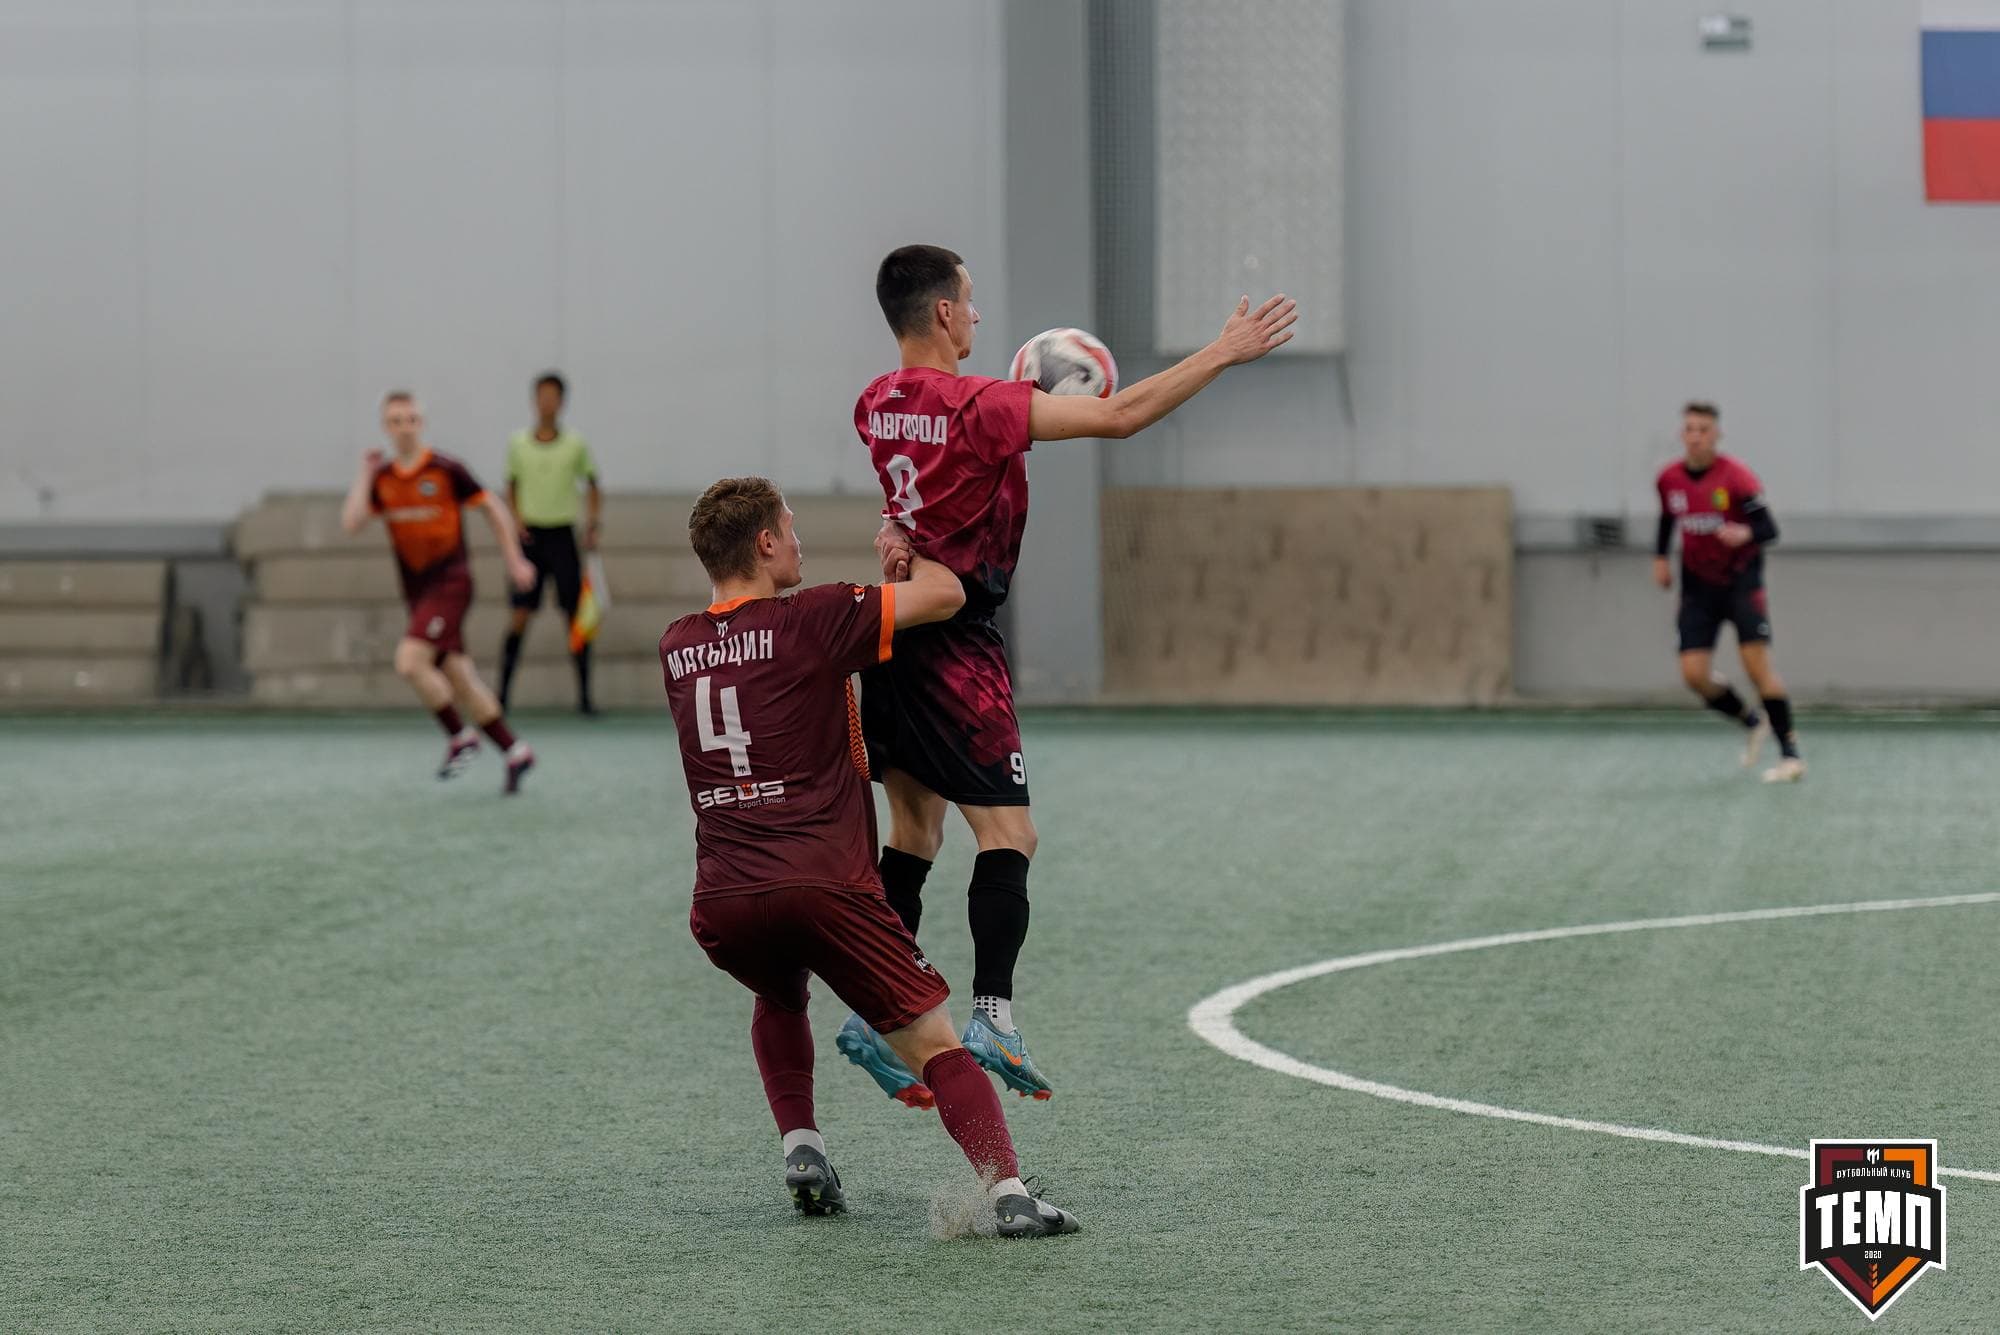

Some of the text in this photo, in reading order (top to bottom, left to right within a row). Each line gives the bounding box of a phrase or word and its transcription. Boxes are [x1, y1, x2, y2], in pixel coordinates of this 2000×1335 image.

[868, 411, 947, 445] АВГОРОД
[667, 629, 774, 681] МАТЫЦИН
[695, 675, 752, 778] 4
[1010, 751, 1026, 785] 9
[738, 795, 786, 809] Export Union
